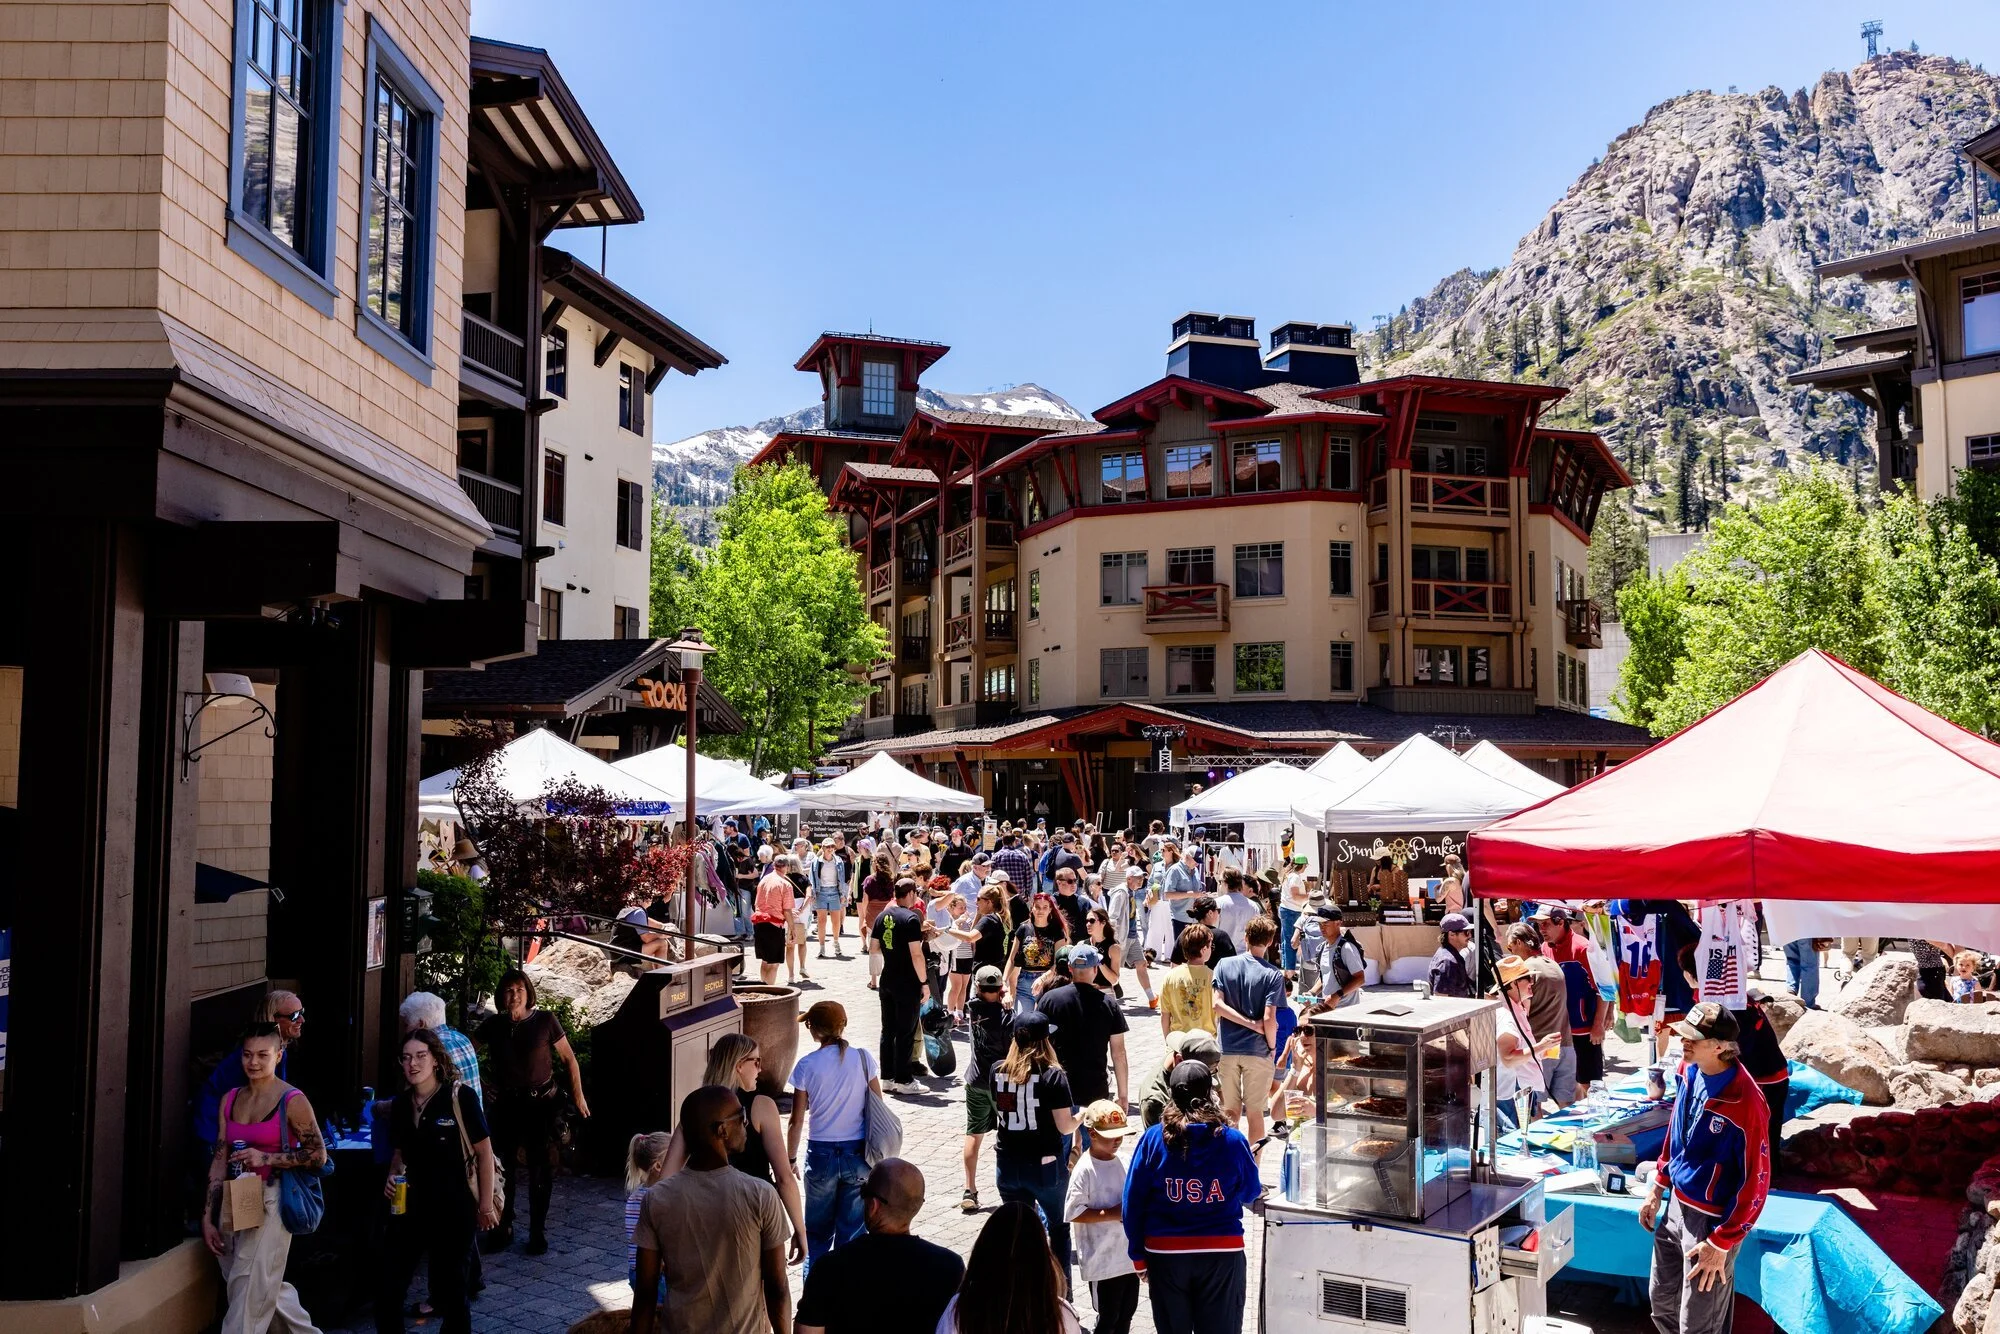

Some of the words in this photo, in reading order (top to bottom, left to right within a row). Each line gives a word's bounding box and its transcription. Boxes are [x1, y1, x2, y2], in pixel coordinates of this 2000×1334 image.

[1337, 838, 1385, 864] Spunk
[1408, 835, 1466, 861] Punker
[704, 979, 724, 992] RECYCLE
[671, 991, 686, 1002] TRASH
[1165, 1177, 1225, 1203] USA
